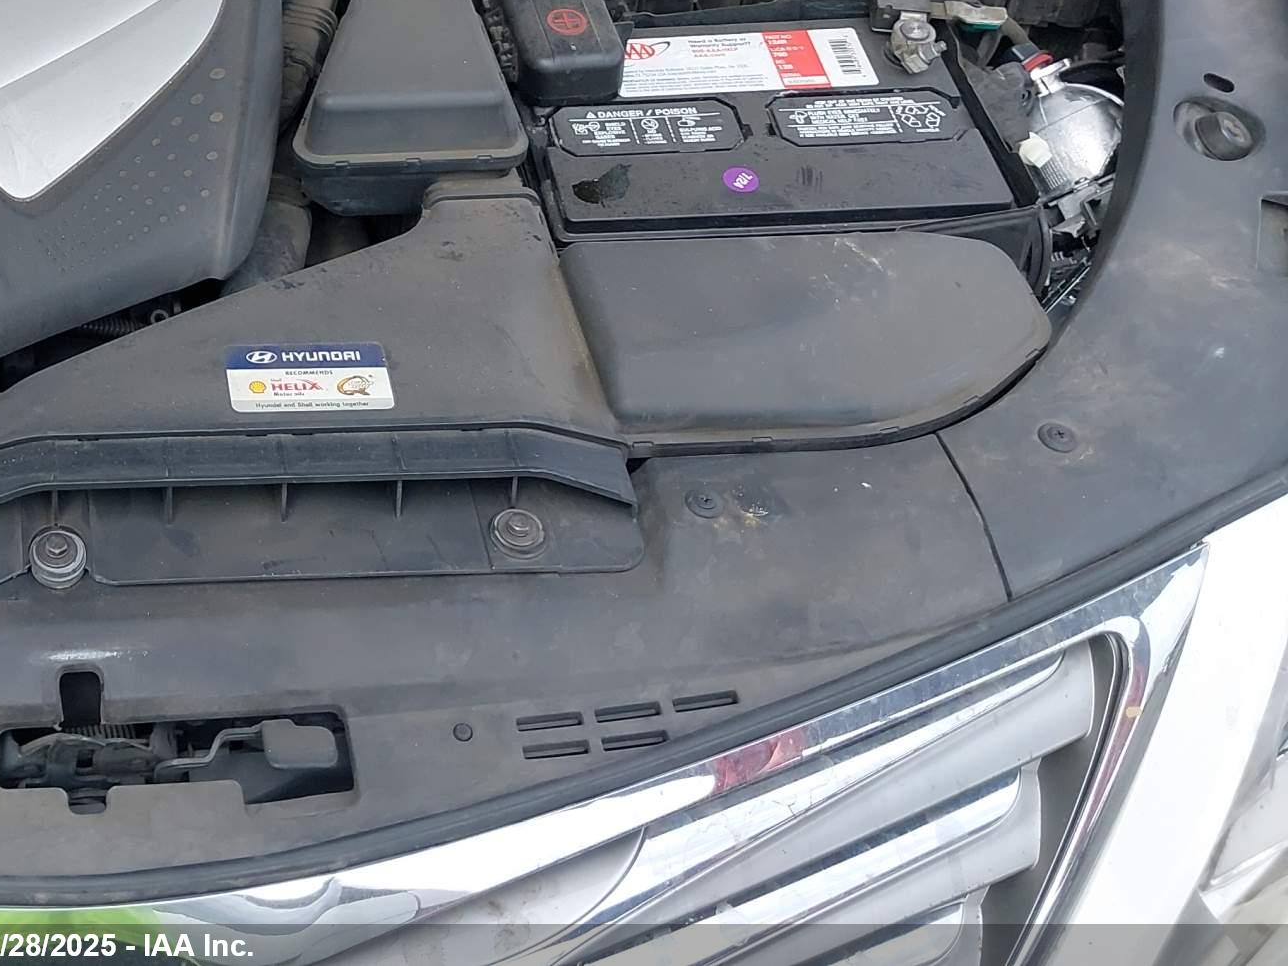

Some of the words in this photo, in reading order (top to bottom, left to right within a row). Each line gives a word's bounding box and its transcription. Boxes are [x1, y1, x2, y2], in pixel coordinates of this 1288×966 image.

[598, 110, 644, 119] DANGER
[655, 107, 698, 116] POISON
[282, 350, 361, 363] HYUNDAI
[271, 382, 323, 391] HELIX
[315, 401, 341, 409] working
[342, 401, 369, 409] together
